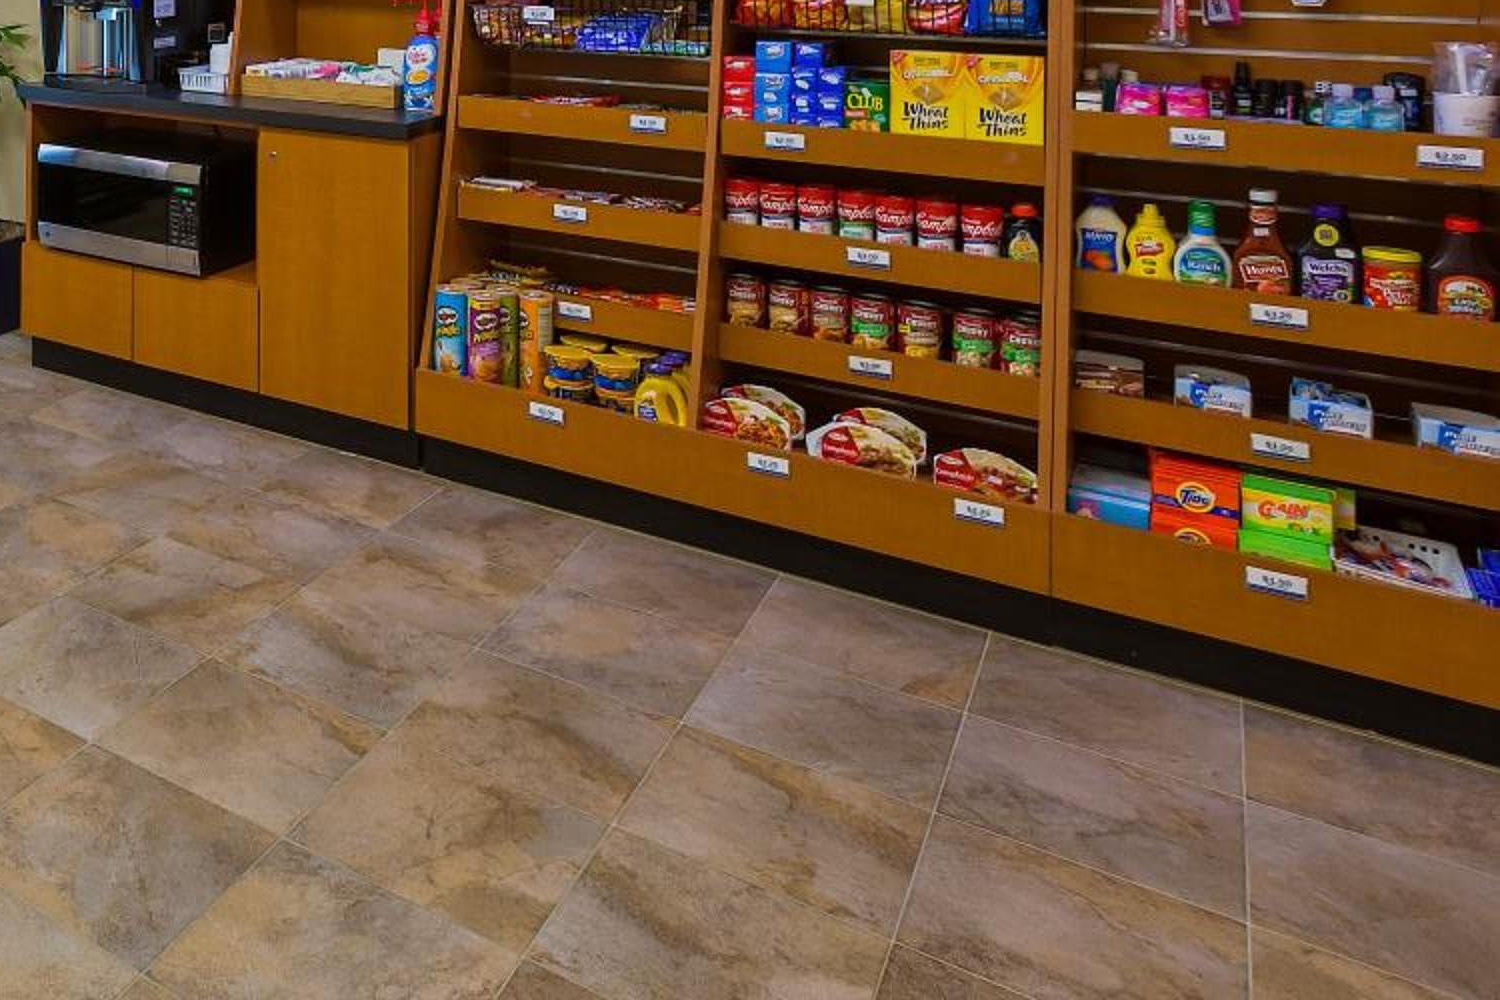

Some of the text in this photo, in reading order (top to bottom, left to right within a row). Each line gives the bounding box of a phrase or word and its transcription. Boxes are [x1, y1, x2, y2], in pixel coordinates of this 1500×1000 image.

[847, 92, 884, 112] CLUB
[904, 101, 949, 119] Wheat
[902, 117, 949, 131] Thins
[980, 107, 1028, 125] Wheat
[978, 122, 1028, 137] Thins
[1180, 487, 1209, 505] Tide
